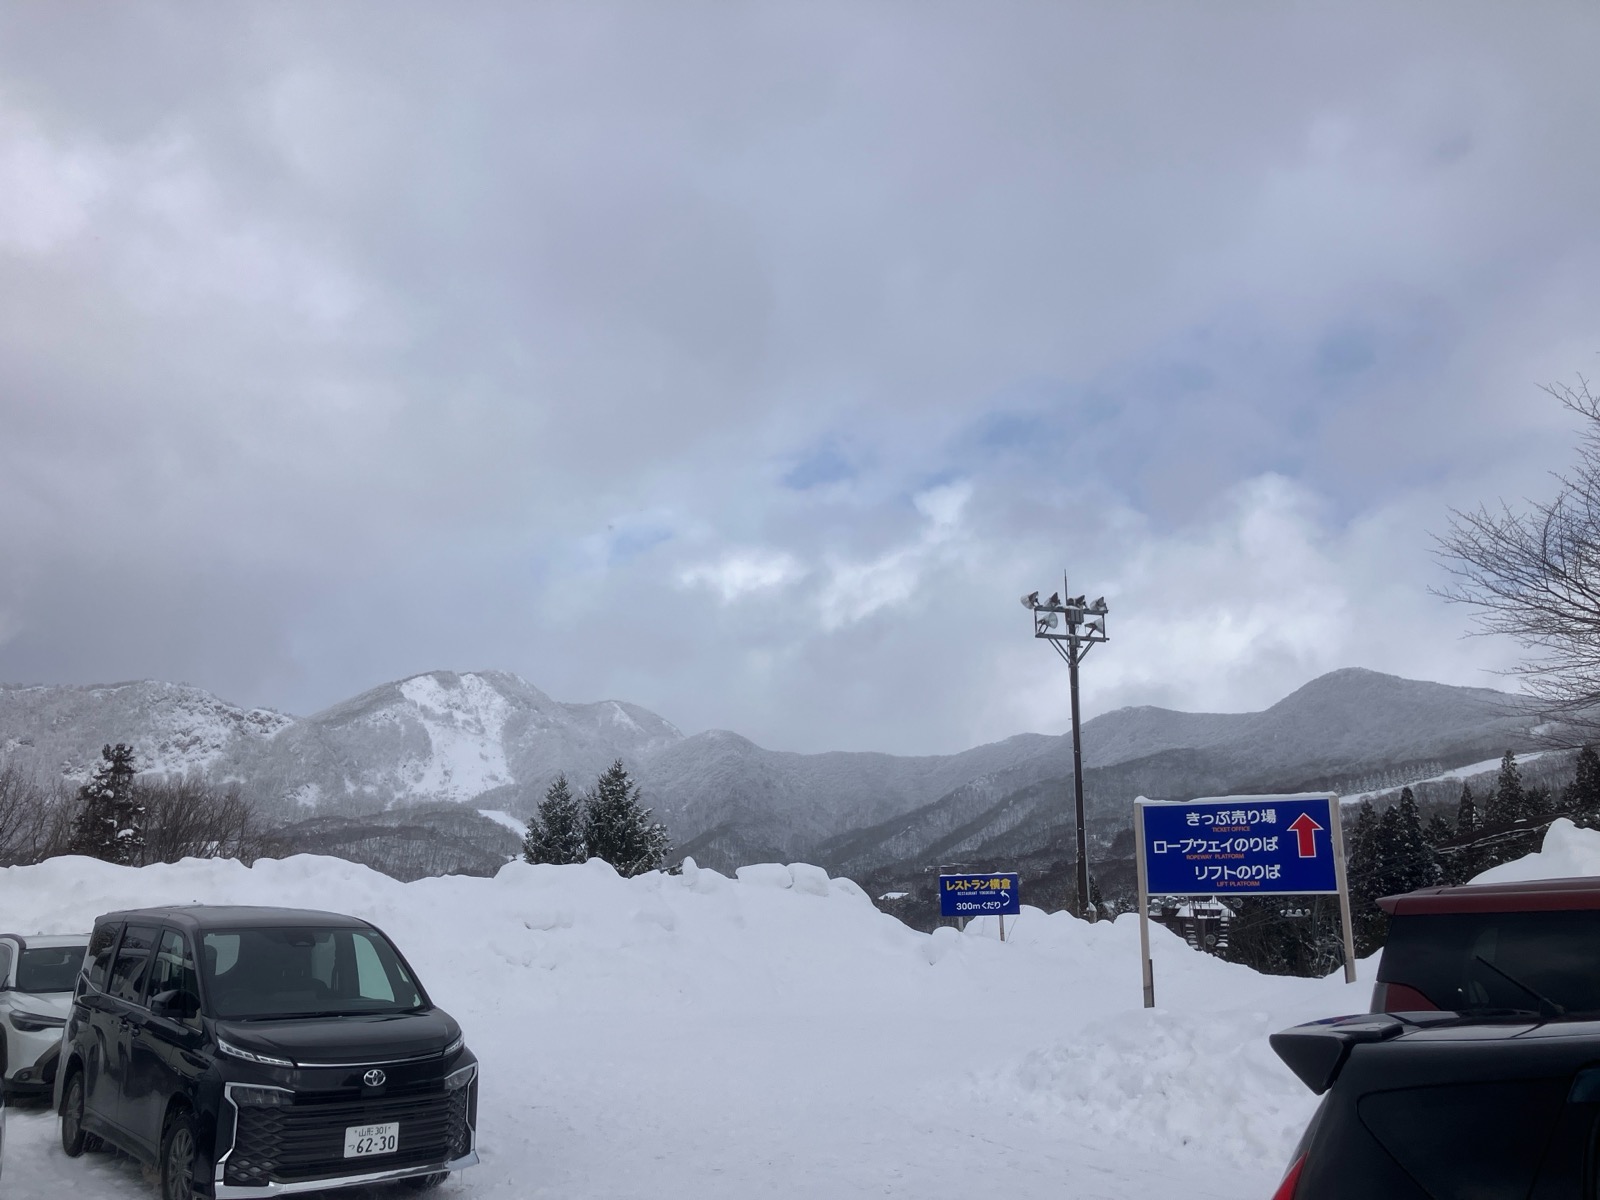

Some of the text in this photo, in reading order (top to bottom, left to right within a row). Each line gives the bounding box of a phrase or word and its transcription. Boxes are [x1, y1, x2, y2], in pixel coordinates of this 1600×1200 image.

[1186, 809, 1276, 826] きっぷ売り場
[1153, 836, 1279, 854] ロープウェイのりば
[1195, 864, 1281, 880] リフトのりば
[946, 879, 1011, 891] レストラン横倉
[359, 1126, 387, 1137] 山形 301
[356, 1135, 395, 1154] 62-30
